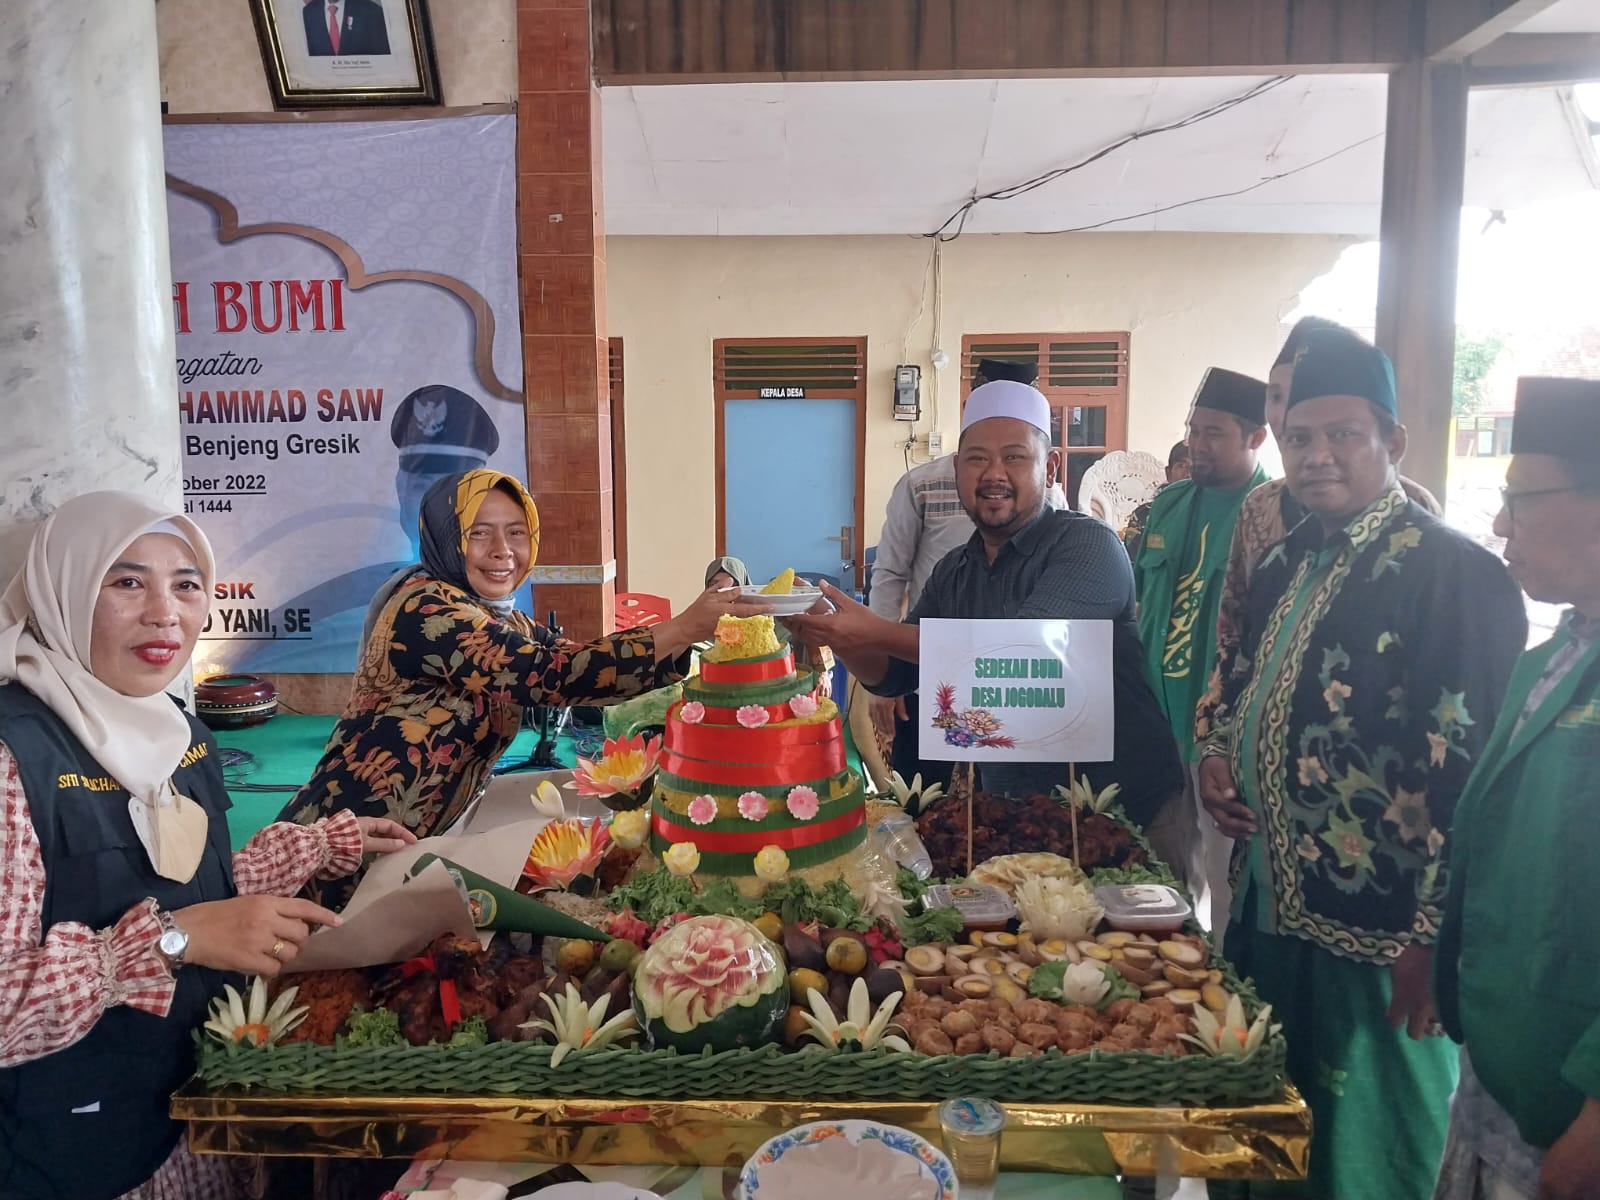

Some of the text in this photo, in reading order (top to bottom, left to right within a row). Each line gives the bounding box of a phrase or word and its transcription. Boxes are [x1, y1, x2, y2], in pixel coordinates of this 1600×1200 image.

[211, 279, 347, 334] BUMI
[760, 388, 804, 398] KEPALA DESA
[316, 387, 384, 422] SAW
[186, 433, 361, 460] Benjeng Gresik
[225, 474, 266, 490] 2022
[198, 499, 233, 513] 1444
[214, 582, 256, 600] SIK
[218, 608, 277, 639] YANI,
[283, 607, 312, 633] SE
[971, 686, 1003, 708] DESA
